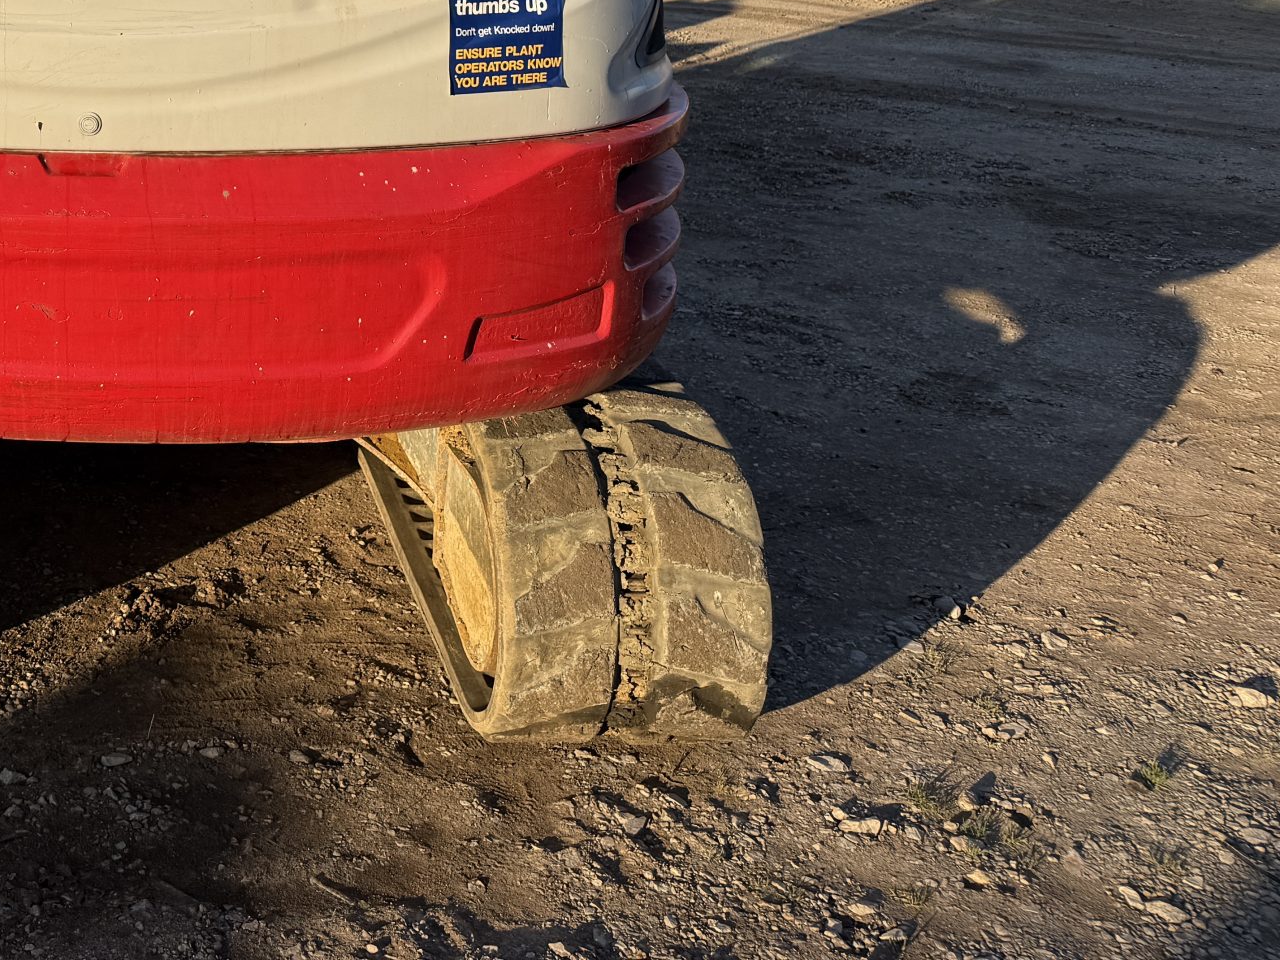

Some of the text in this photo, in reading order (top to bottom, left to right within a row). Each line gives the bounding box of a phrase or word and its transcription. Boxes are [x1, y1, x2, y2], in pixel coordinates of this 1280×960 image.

[456, 23, 554, 37] Don't get Knocked down!
[456, 44, 544, 60] ENSURE PLANT
[455, 57, 562, 74] OPERATORS KNOW
[455, 72, 547, 88] YOU ARE THERE
